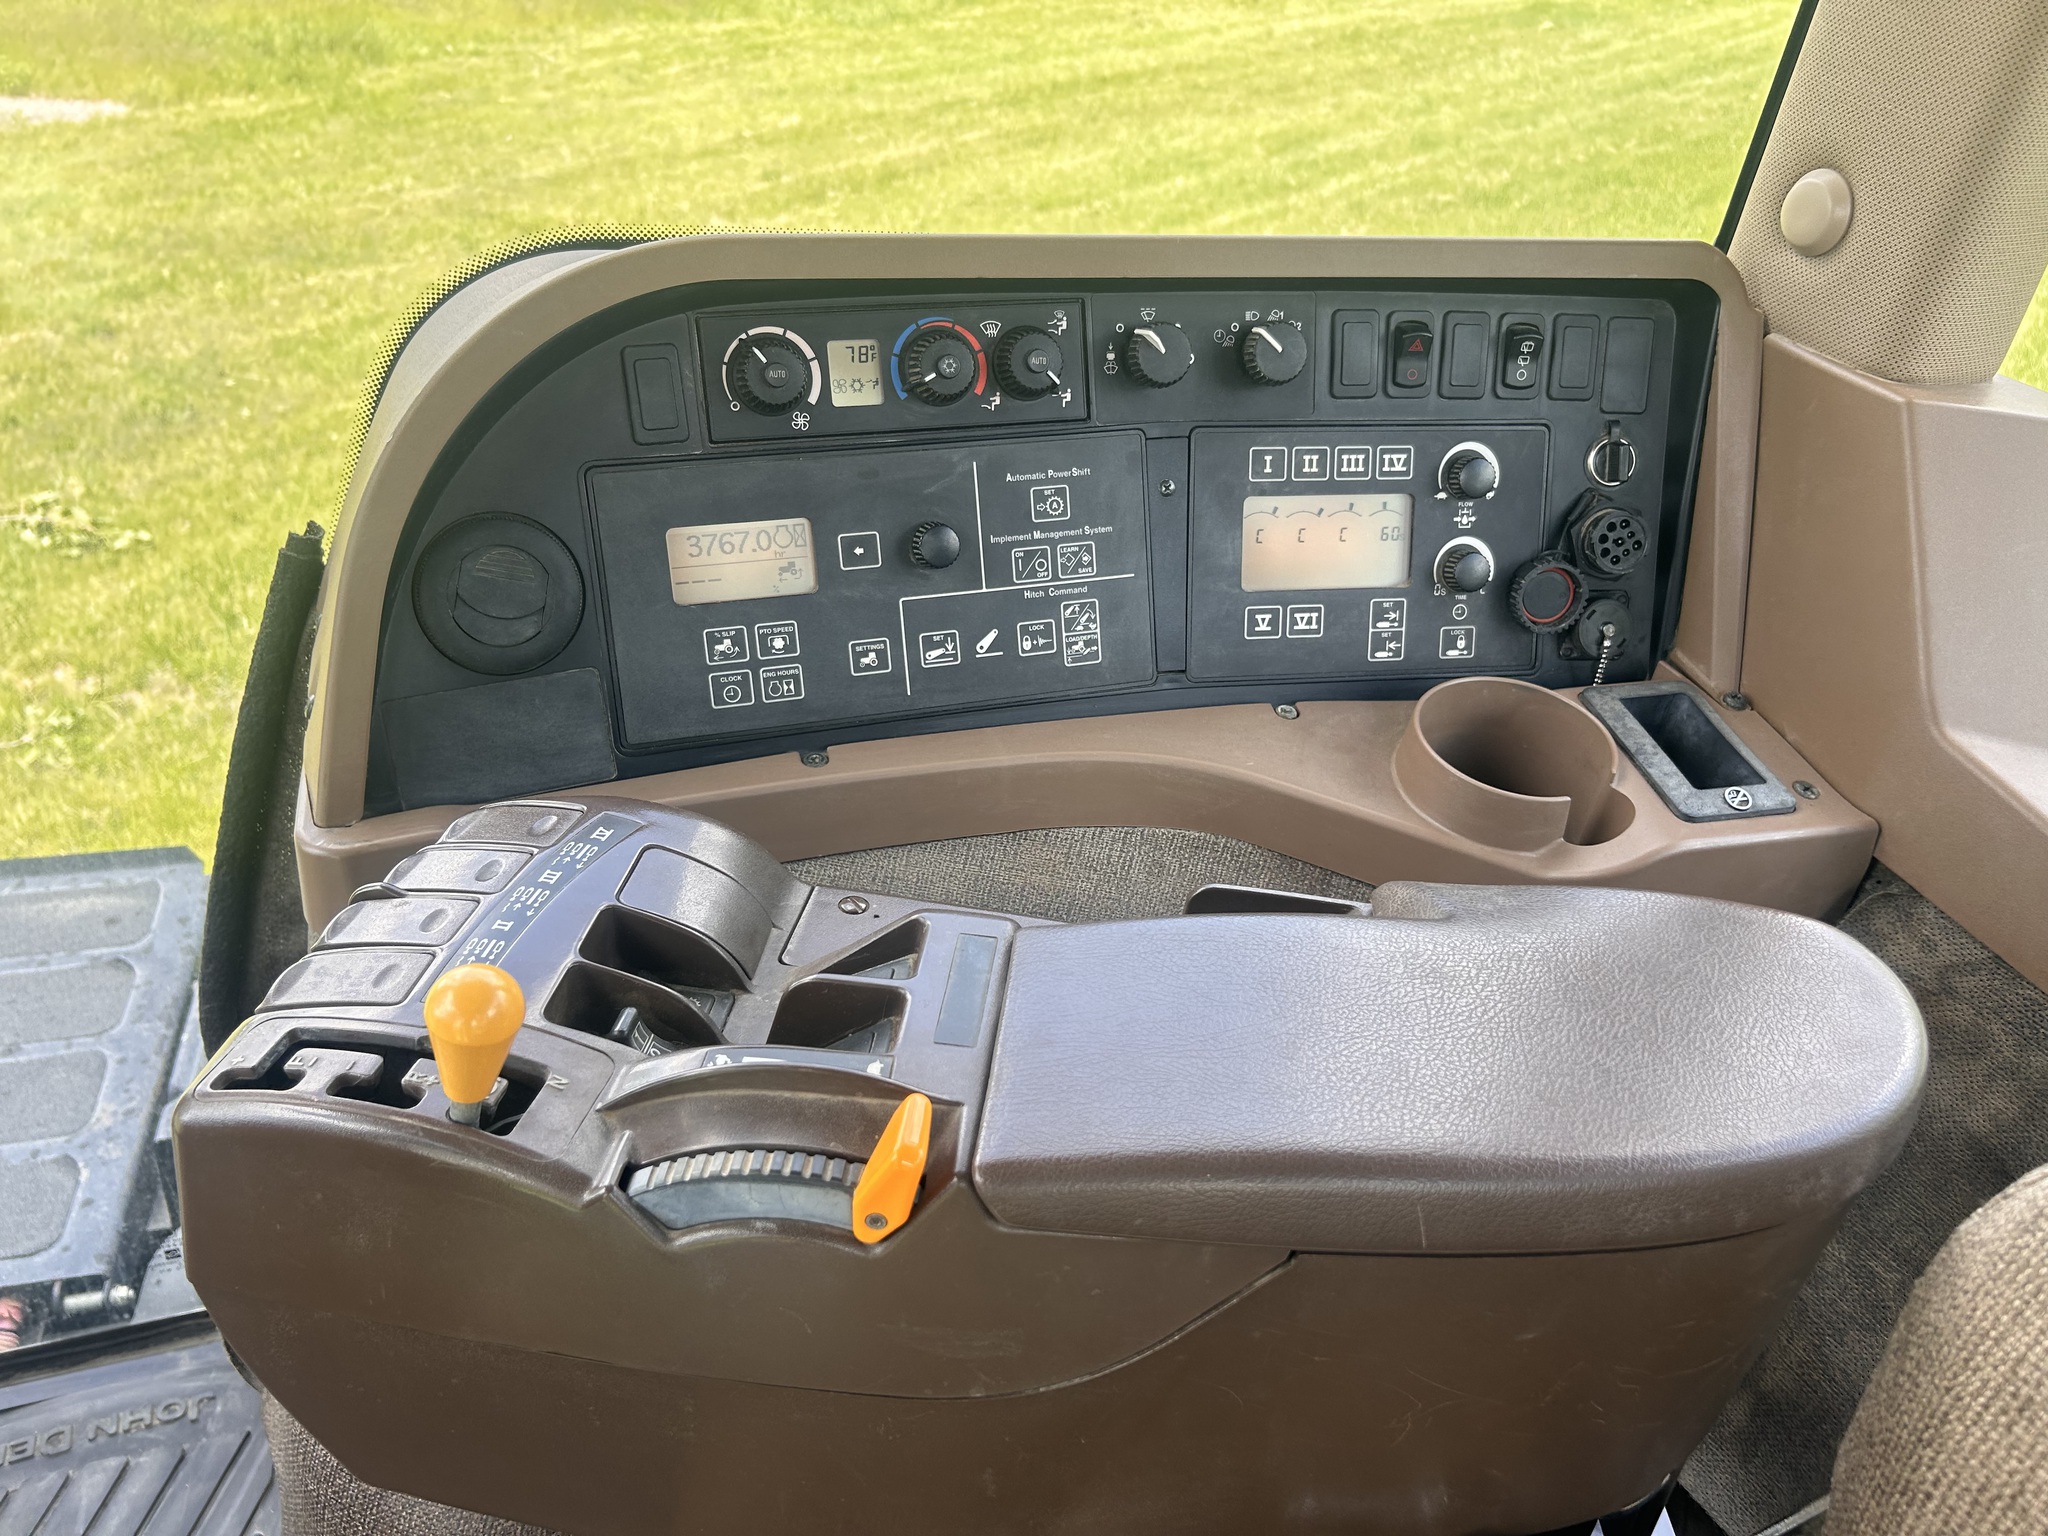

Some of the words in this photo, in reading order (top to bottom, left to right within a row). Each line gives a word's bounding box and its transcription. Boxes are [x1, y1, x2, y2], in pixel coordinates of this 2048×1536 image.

[1031, 356, 1047, 366] AUTO
[768, 369, 786, 379] AUTO
[1340, 454, 1366, 472] III
[1382, 453, 1408, 472] IV
[1005, 471, 1046, 483] Automatic
[990, 532, 1032, 546] Implement
[1033, 527, 1083, 541] Management
[1084, 524, 1113, 537] System
[685, 529, 773, 558] 3767.0
[1024, 588, 1045, 599] Hitch
[1048, 585, 1088, 597] Command
[1028, 623, 1045, 631] LOCK
[1254, 613, 1272, 631] V
[1292, 612, 1319, 630] VI
[721, 630, 736, 638] SLIP
[759, 627, 772, 635] PTO
[772, 625, 794, 634] SPEED
[855, 643, 885, 652] SETTINGS
[720, 674, 743, 682] CLOCK
[777, 668, 799, 677] HOURS
[87, 1393, 217, 1443] JOHN
